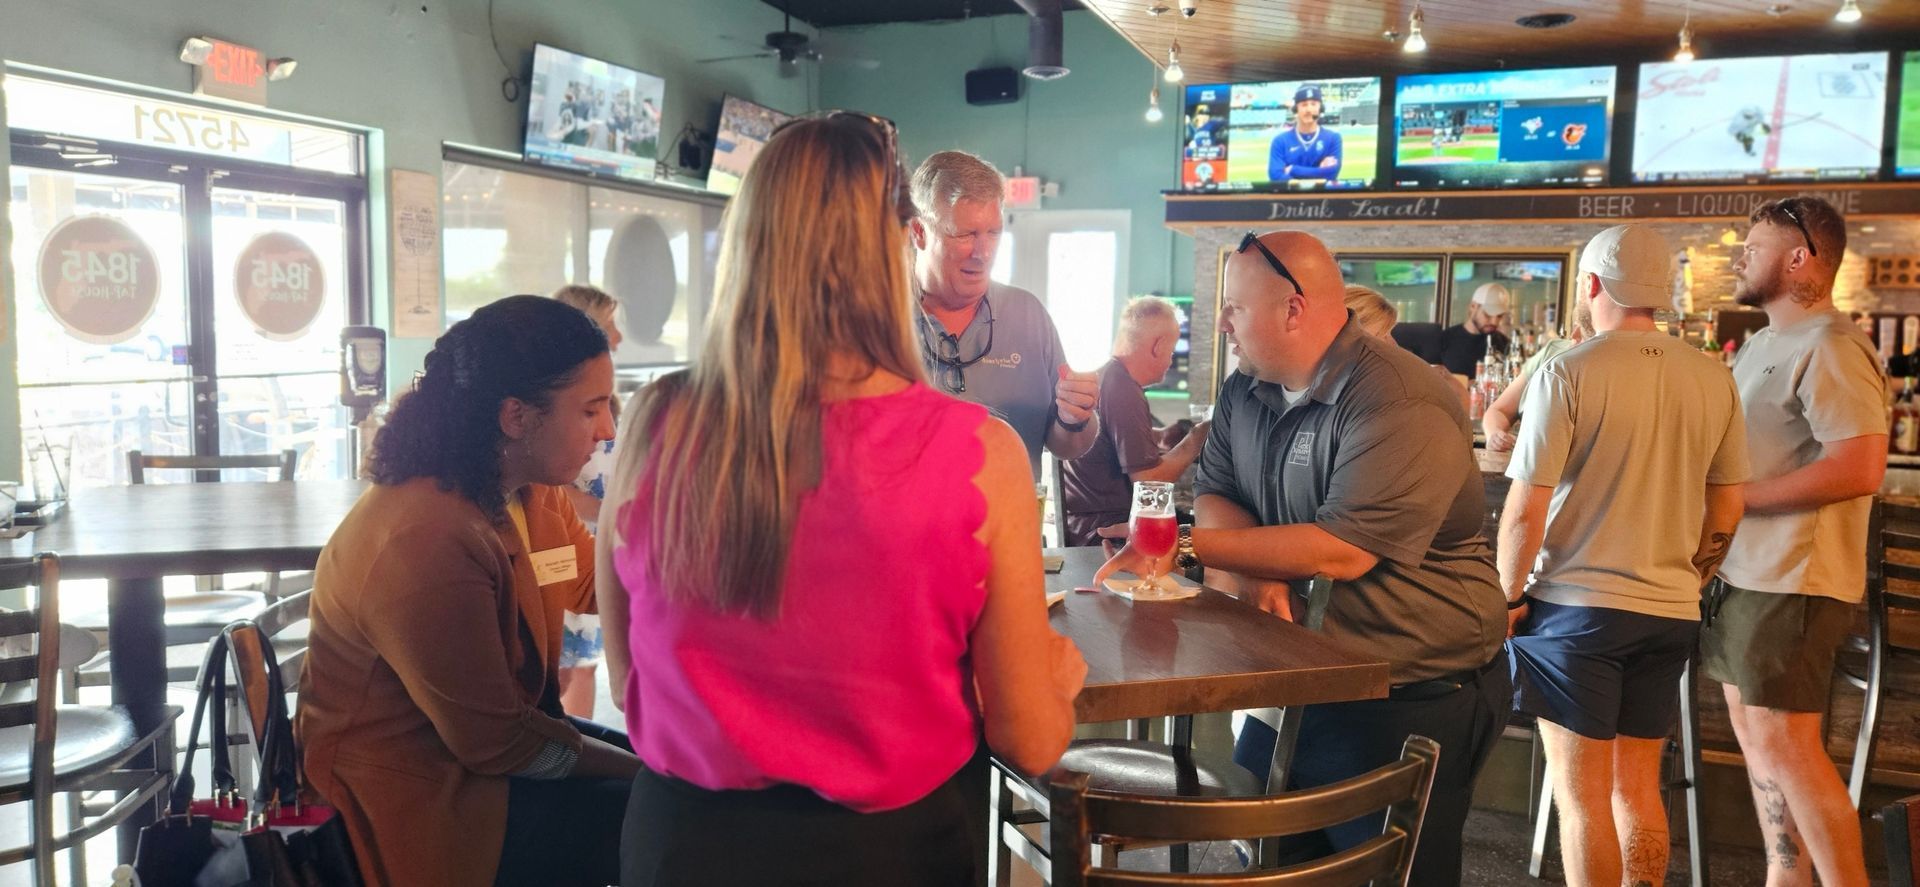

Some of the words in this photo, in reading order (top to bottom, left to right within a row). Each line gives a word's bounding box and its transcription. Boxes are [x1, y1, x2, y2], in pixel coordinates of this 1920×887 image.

[214, 42, 258, 88] EXIT
[1438, 82, 1487, 97] EXTRA
[1267, 199, 1334, 220] Drink
[1349, 197, 1441, 218] Local!
[1578, 195, 1636, 218] BEER
[1676, 193, 1763, 217] LIQUOR
